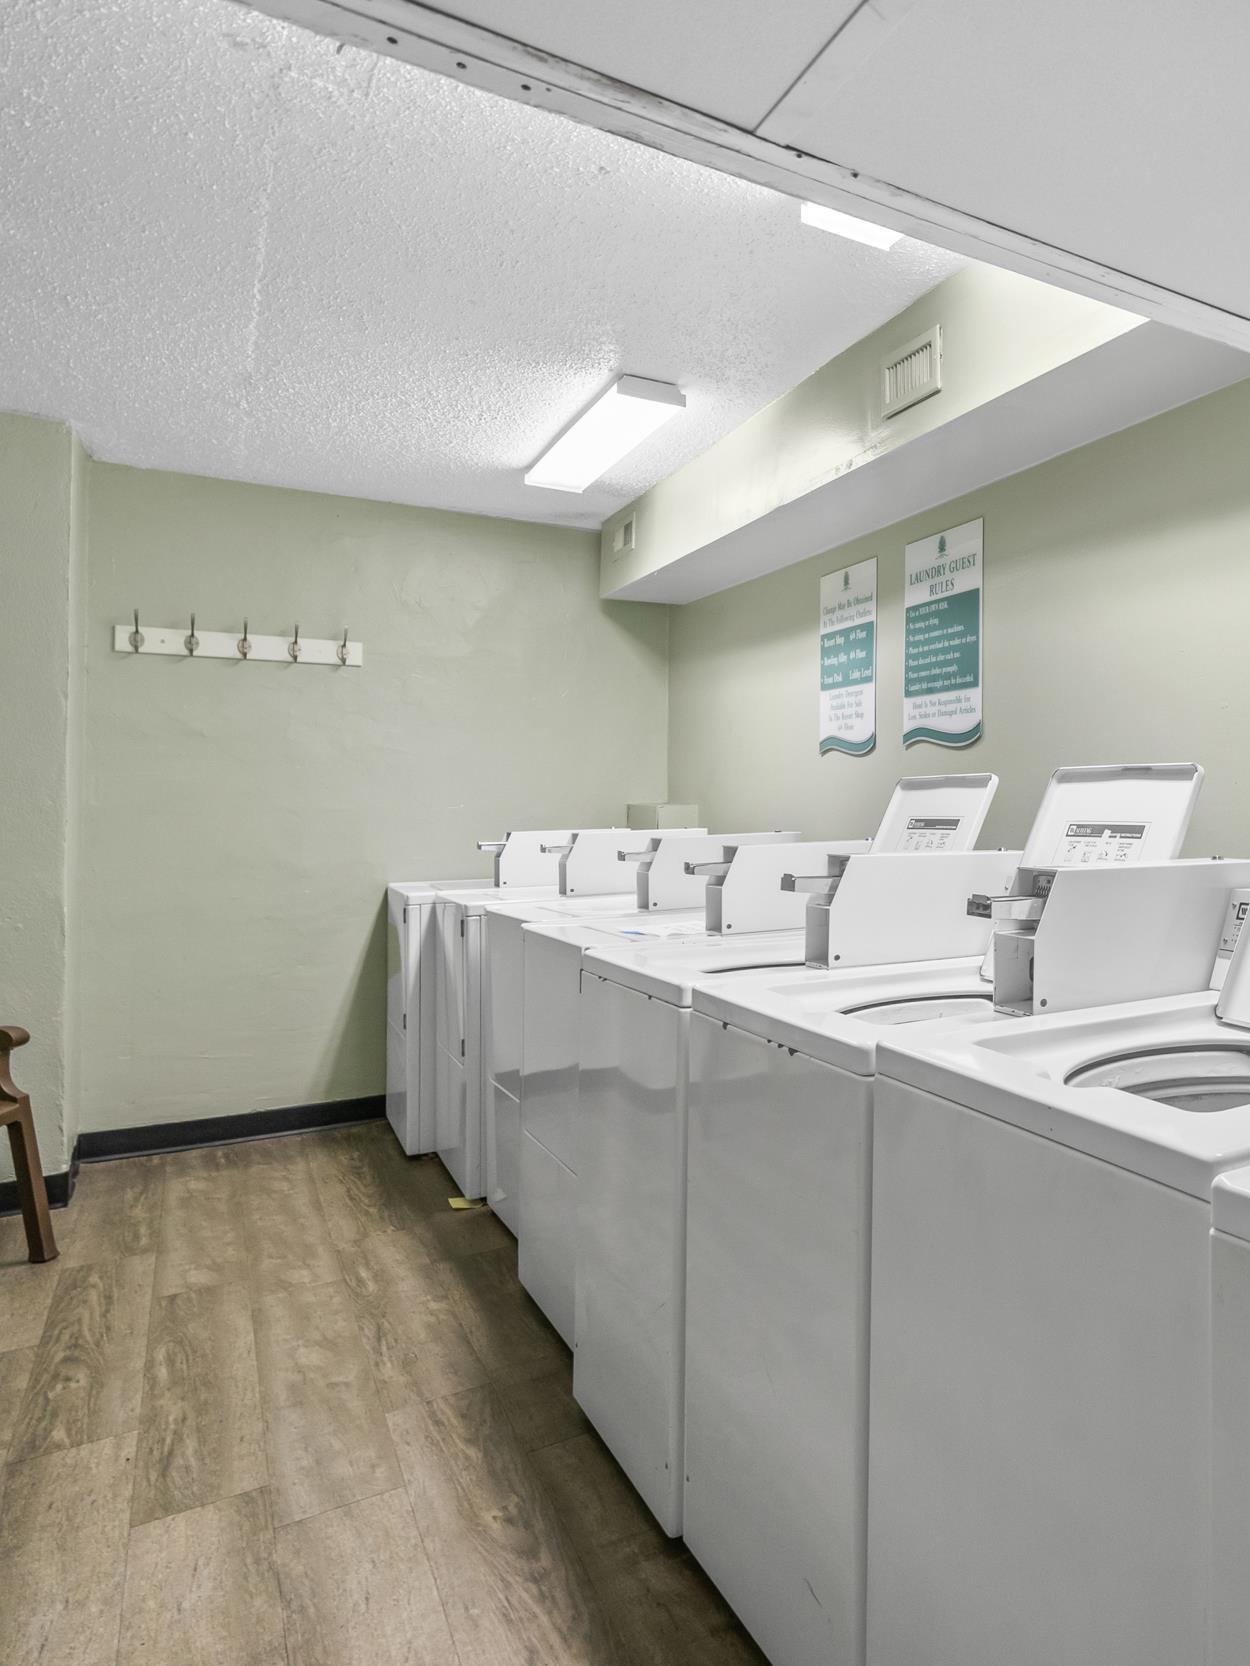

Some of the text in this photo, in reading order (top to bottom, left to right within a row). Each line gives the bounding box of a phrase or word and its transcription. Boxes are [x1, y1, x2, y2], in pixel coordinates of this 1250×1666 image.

[910, 554, 976, 585] LAUNDRY GUEST
[930, 578, 955, 597] RULES
